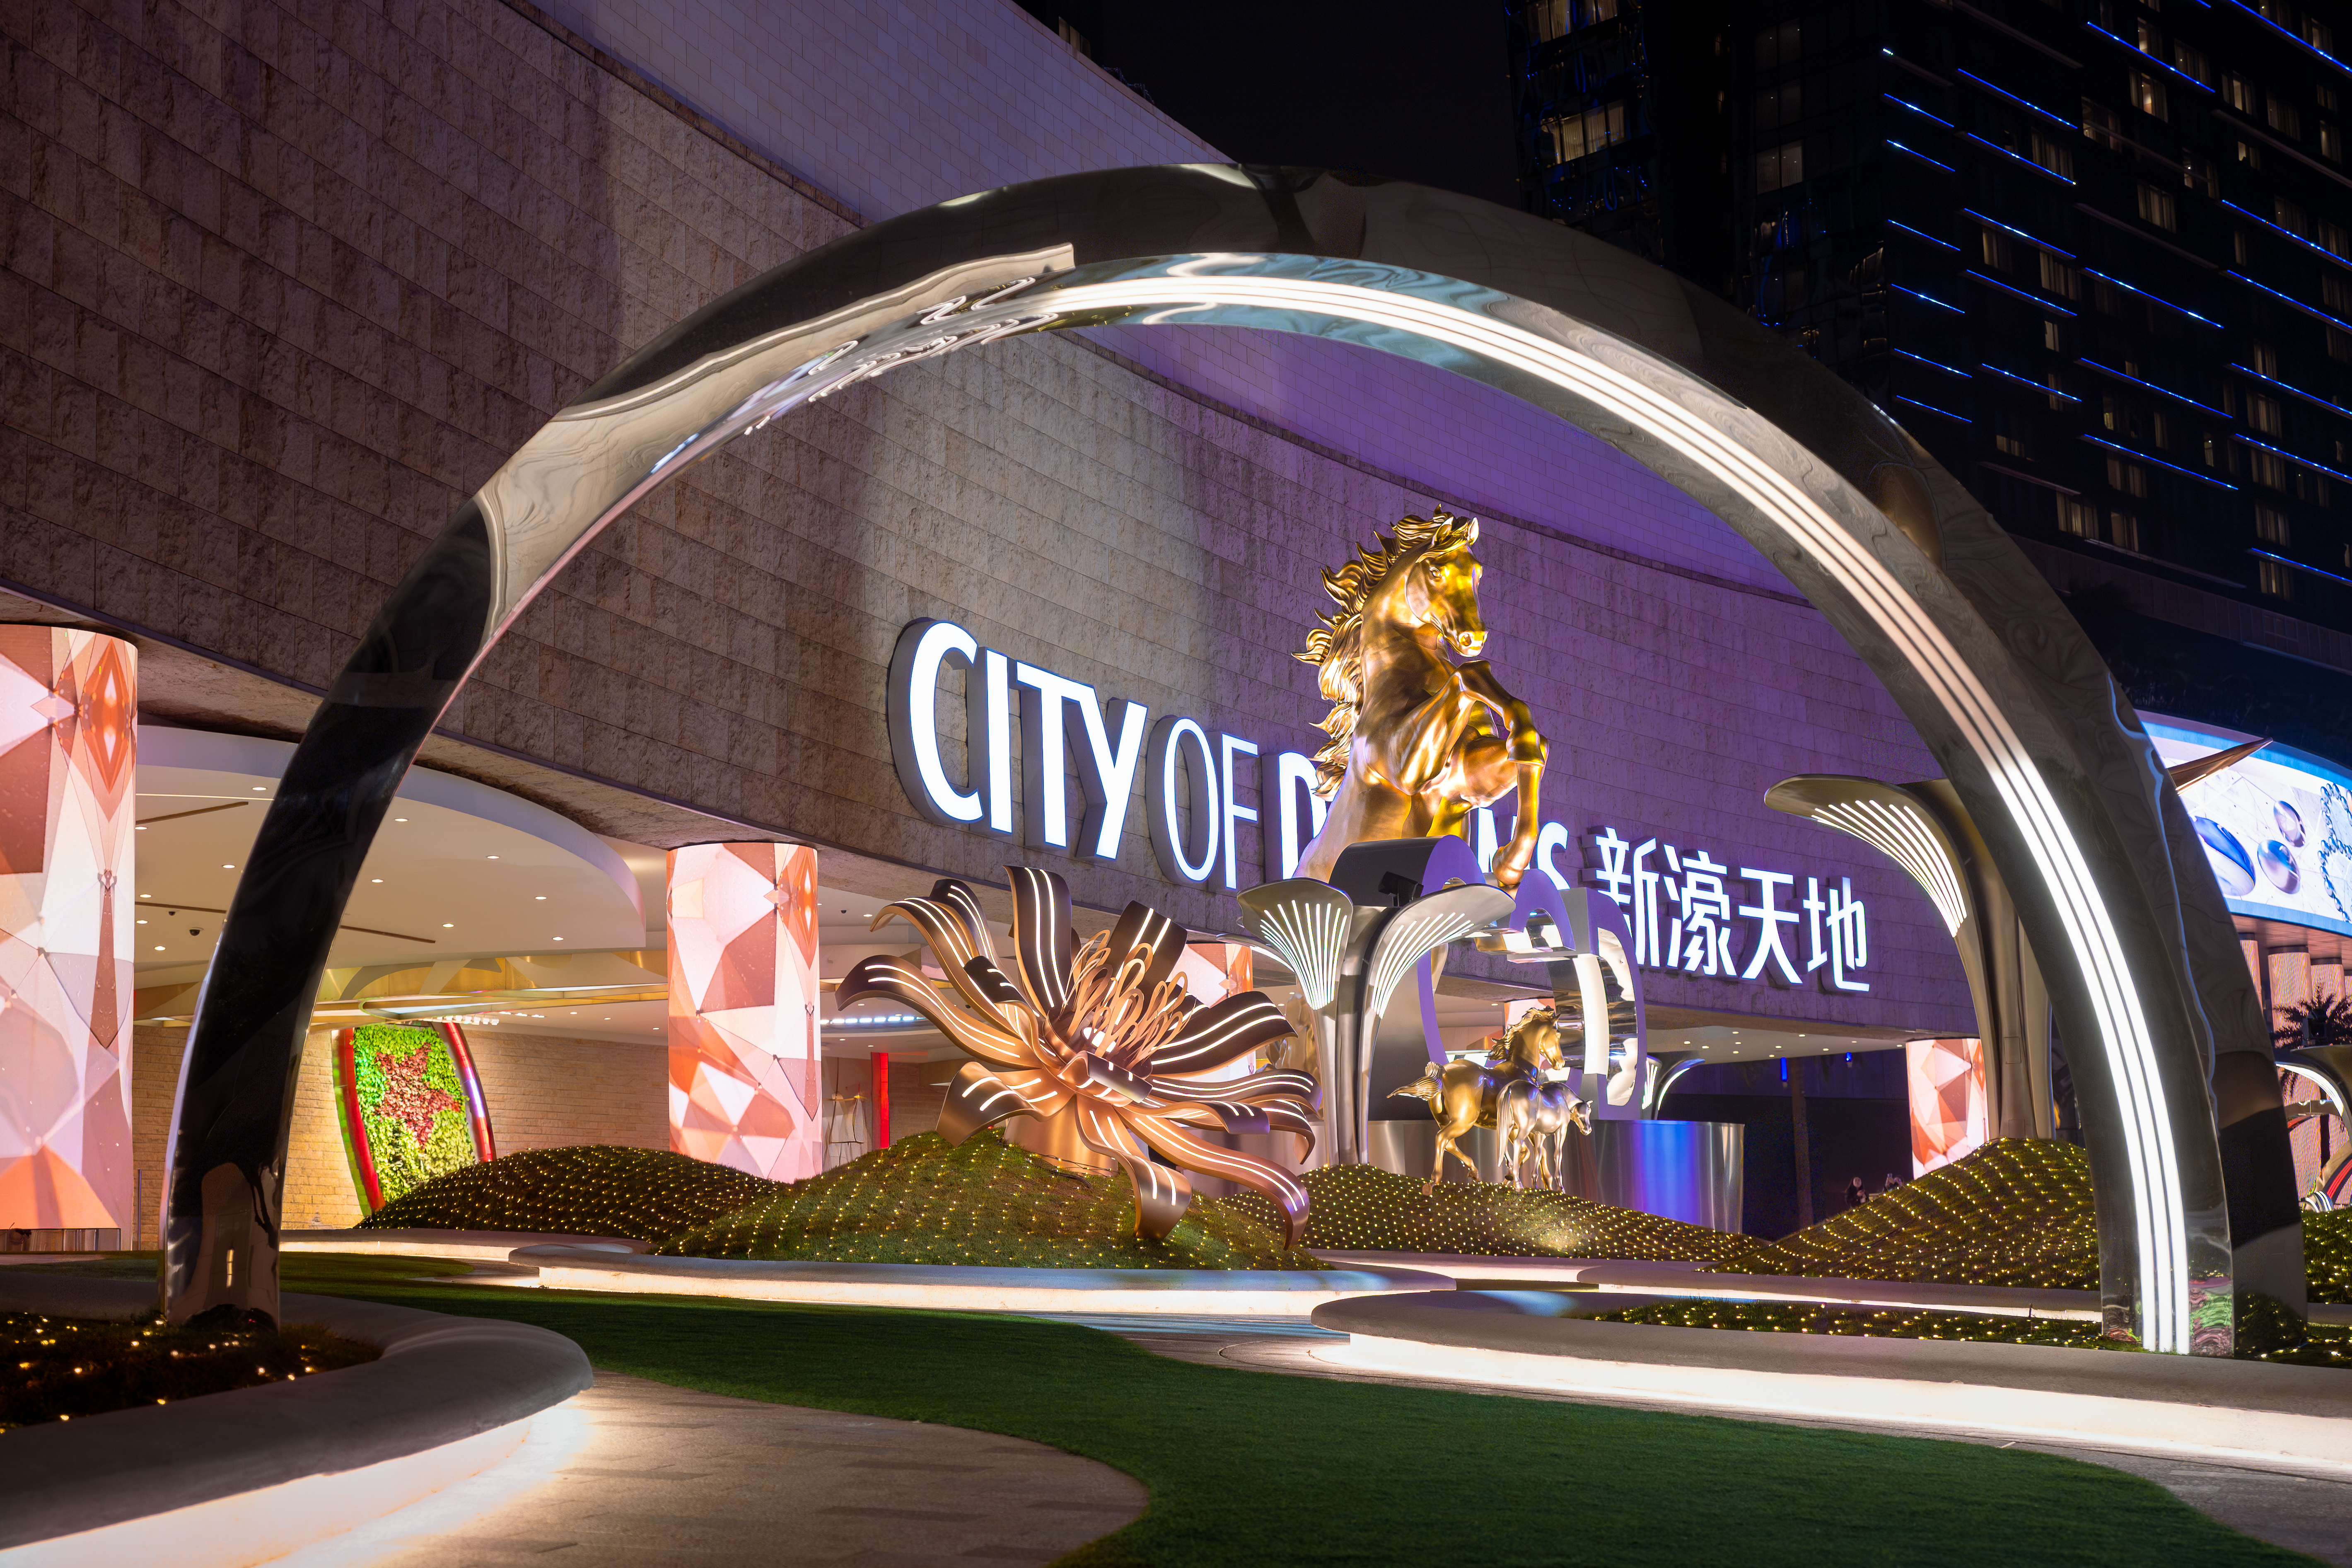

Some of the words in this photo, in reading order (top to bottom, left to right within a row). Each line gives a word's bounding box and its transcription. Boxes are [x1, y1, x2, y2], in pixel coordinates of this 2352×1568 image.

[910, 621, 1148, 859] CITY
[1165, 718, 1258, 889] OF
[1596, 827, 1870, 992] 新濠天地
